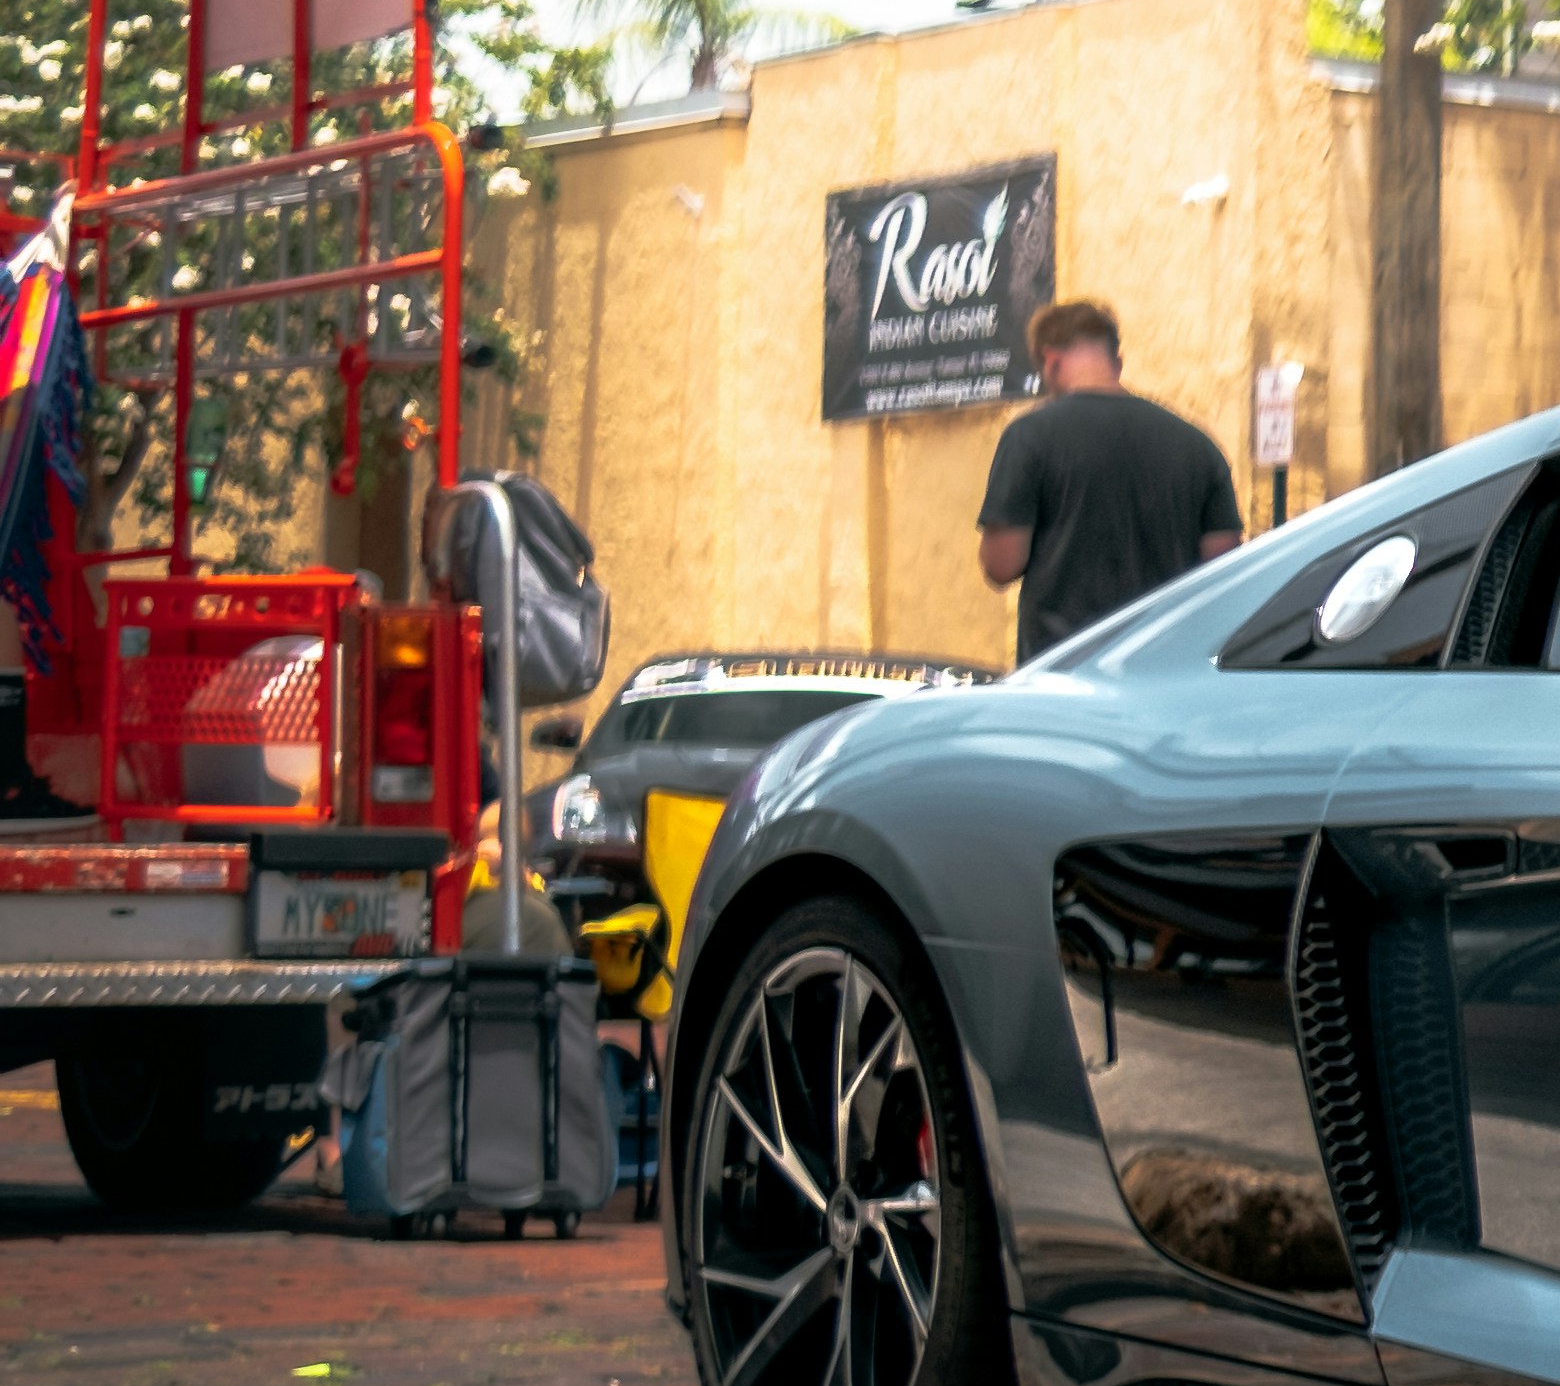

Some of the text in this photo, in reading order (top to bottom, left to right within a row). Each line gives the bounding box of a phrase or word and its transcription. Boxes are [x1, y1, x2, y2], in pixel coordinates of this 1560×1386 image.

[868, 182, 1009, 319] Rasoi
[869, 304, 999, 353] INDIAN CUISINE
[212, 1081, 320, 1115] アトラス
